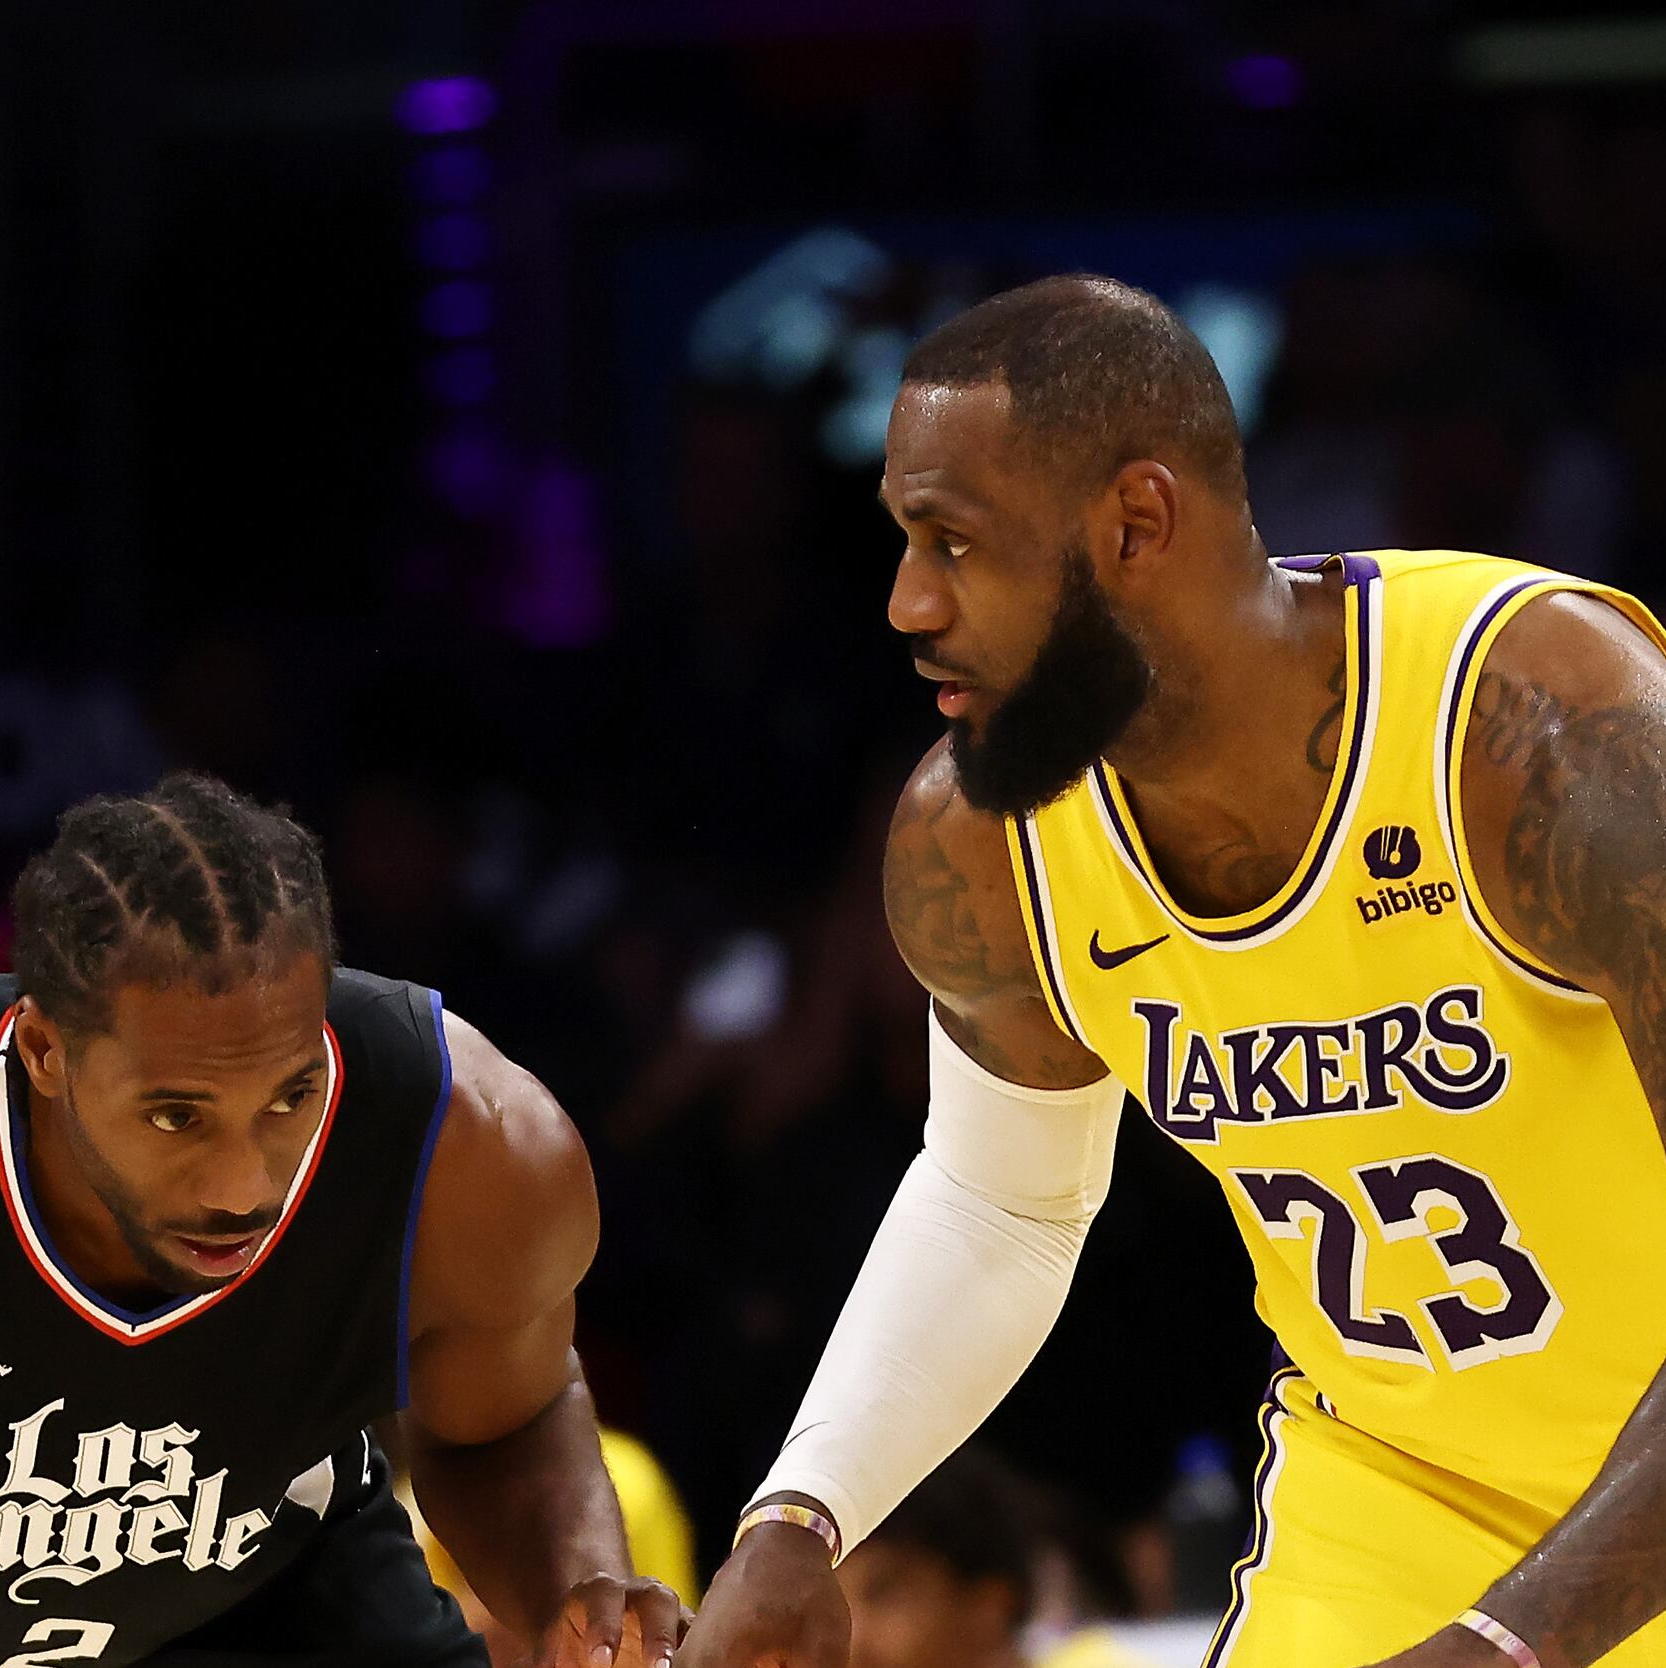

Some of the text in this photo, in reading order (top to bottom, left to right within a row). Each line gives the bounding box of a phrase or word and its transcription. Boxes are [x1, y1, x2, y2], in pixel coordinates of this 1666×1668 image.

[1356, 880, 1456, 925] bibigo
[1132, 986, 1510, 1143] LAKERS
[1229, 1155, 1564, 1371] 23
